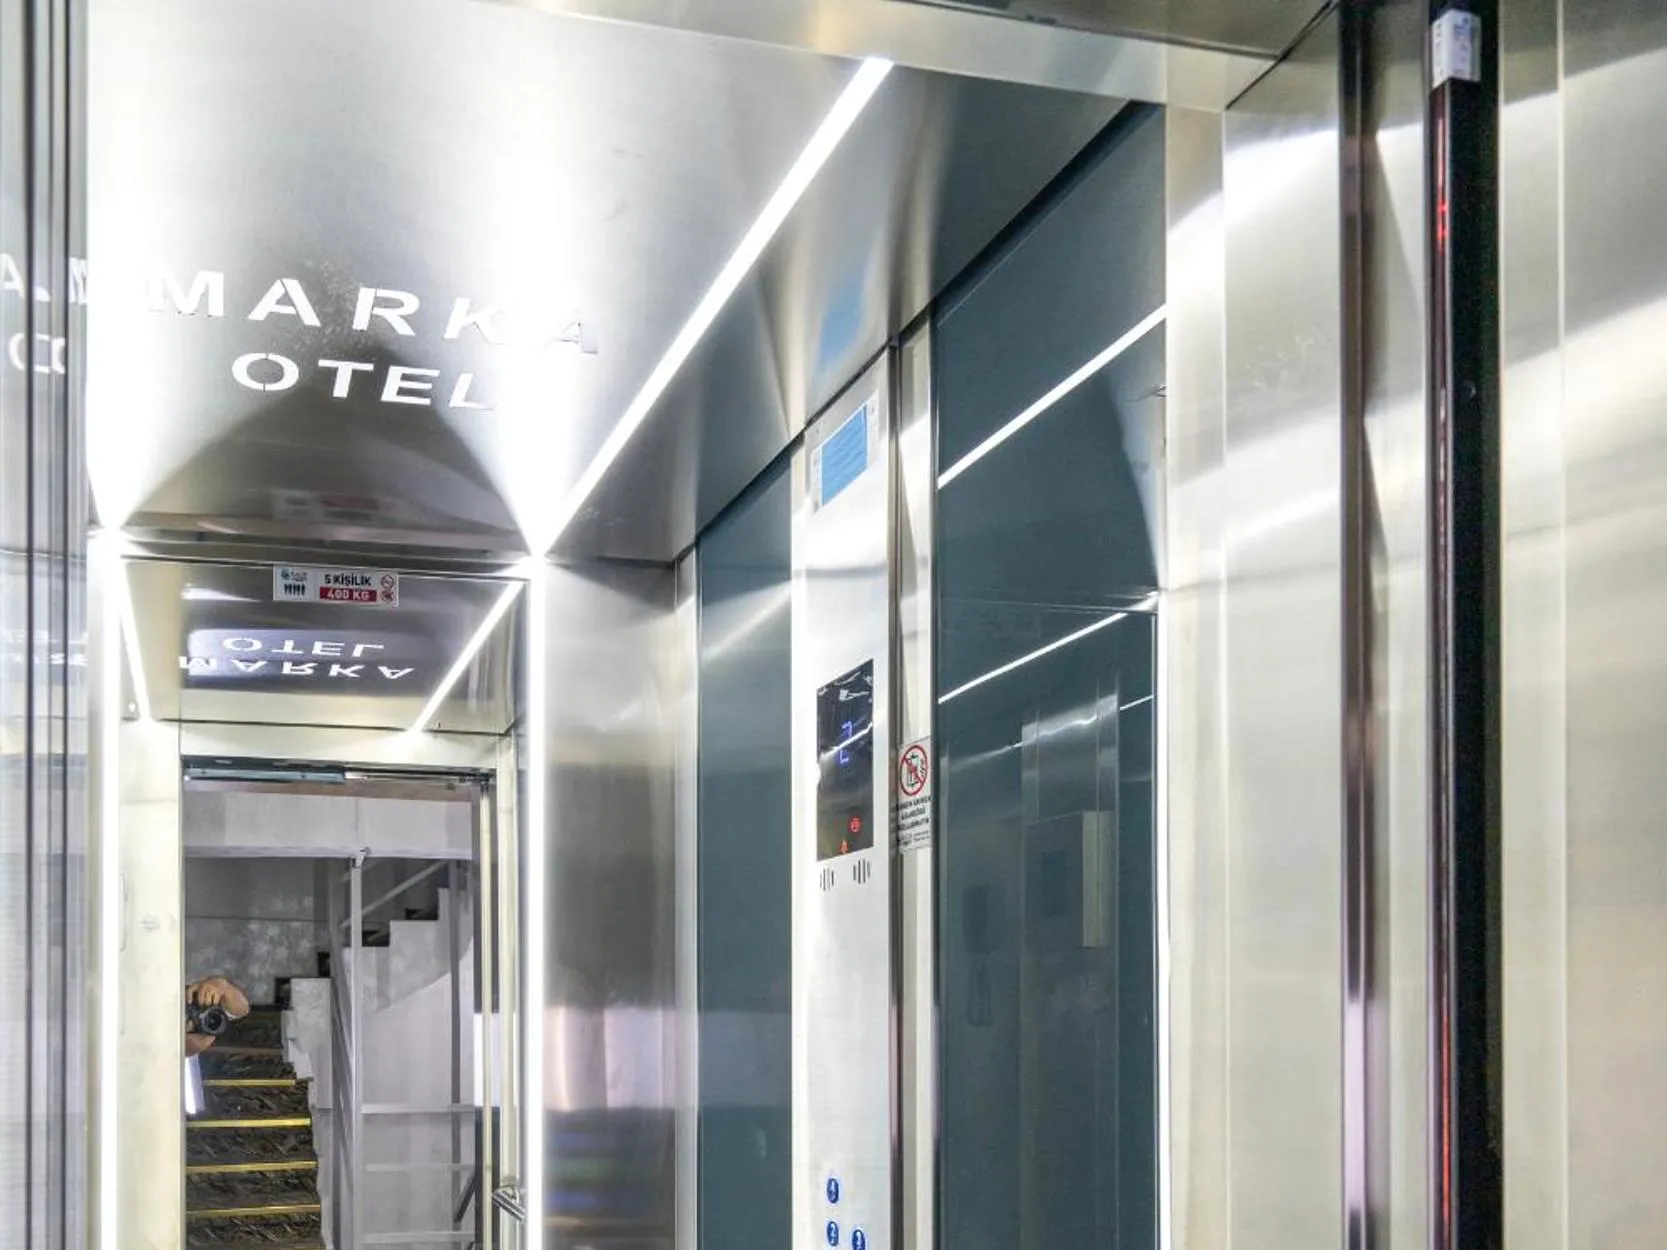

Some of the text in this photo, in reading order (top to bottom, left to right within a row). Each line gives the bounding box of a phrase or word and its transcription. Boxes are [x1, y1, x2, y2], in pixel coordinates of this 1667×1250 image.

[147, 270, 598, 354] MARKA
[231, 352, 495, 410] OTEL
[324, 573, 332, 585] 5
[353, 590, 371, 600] KG
